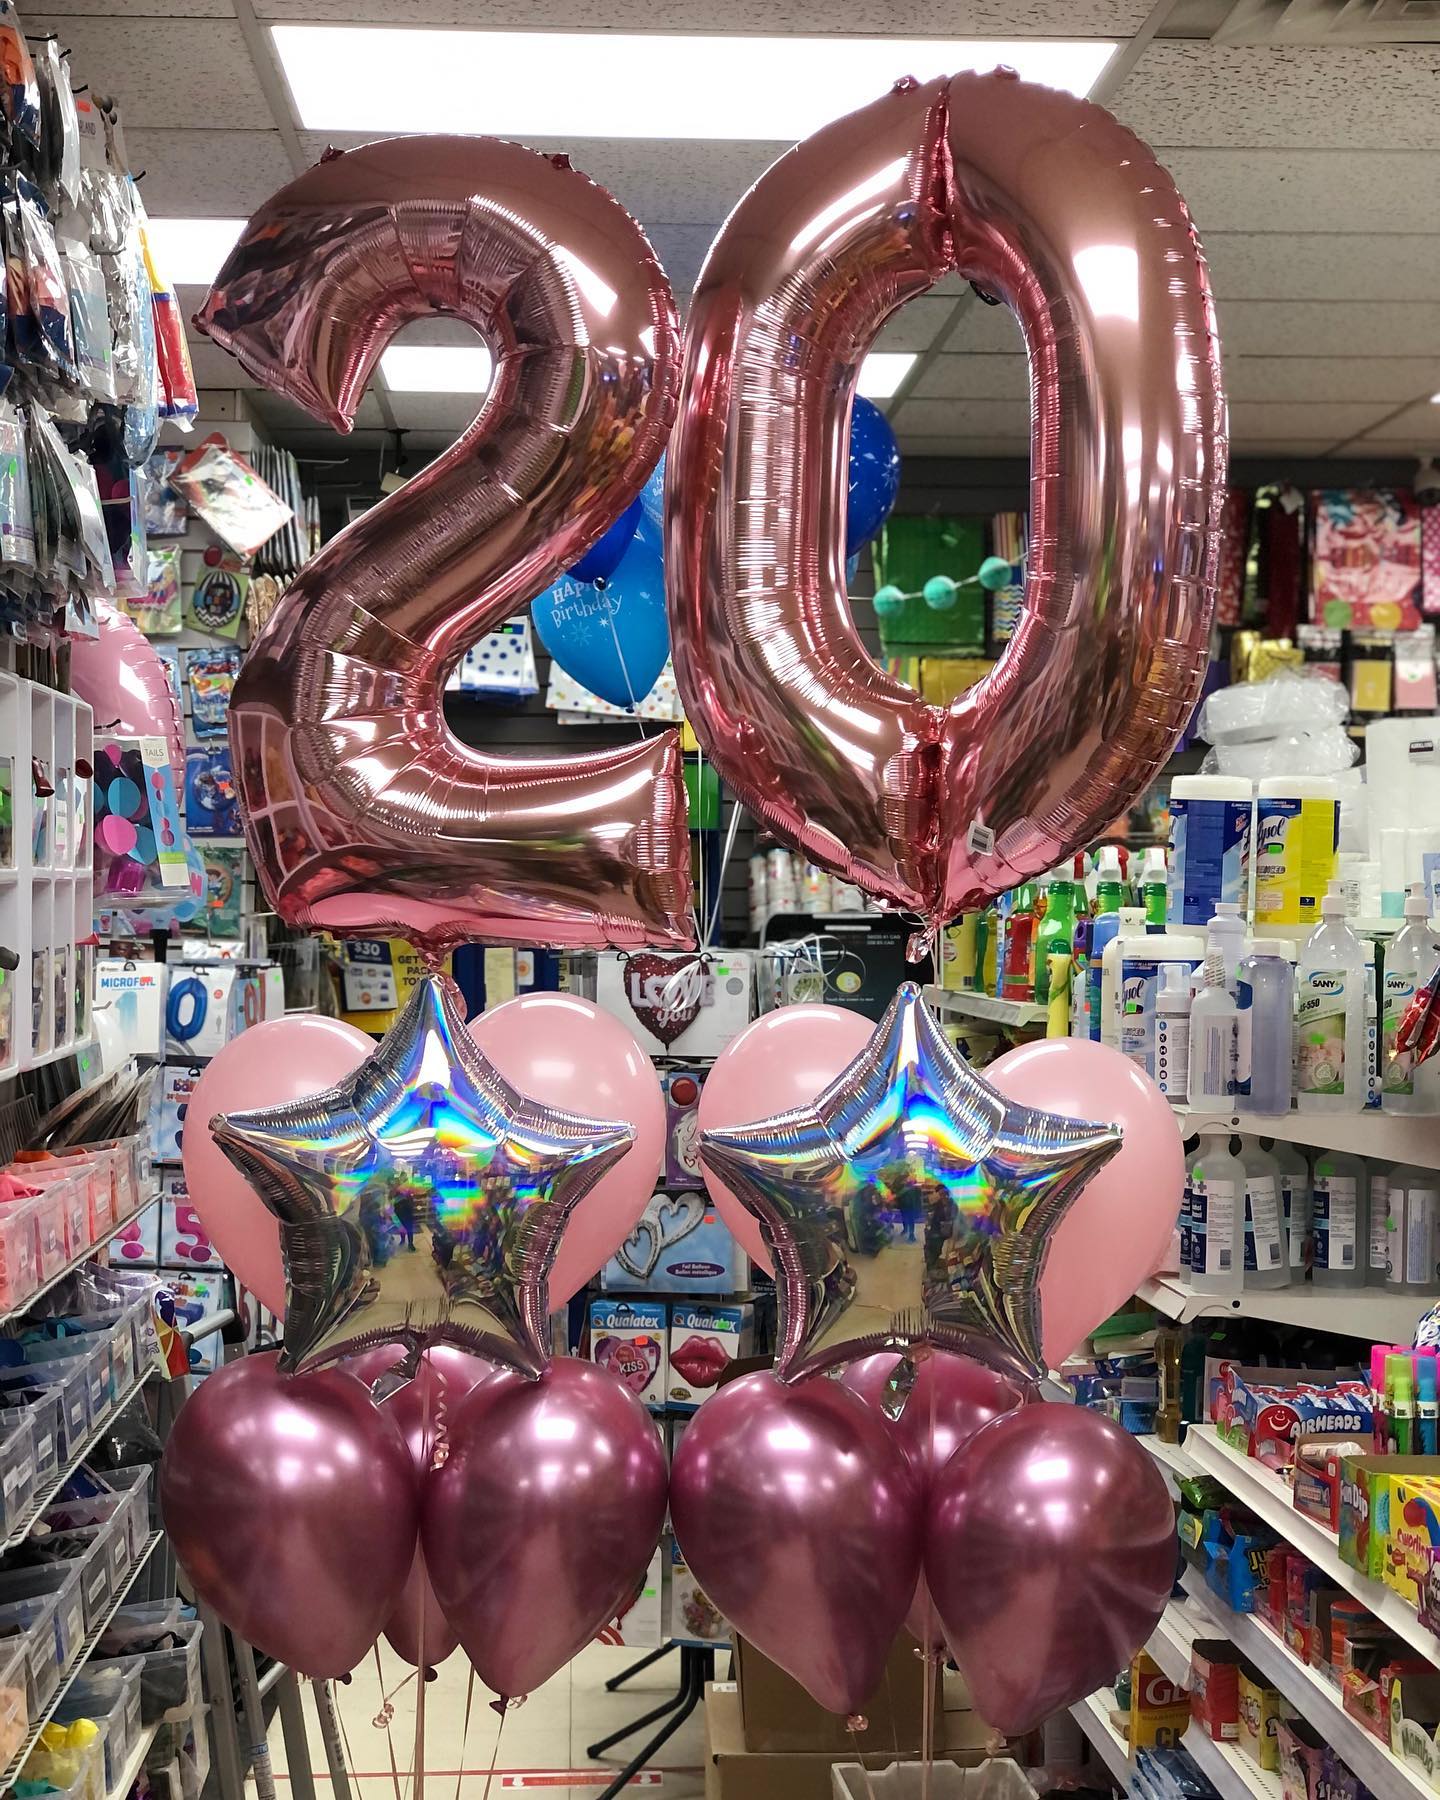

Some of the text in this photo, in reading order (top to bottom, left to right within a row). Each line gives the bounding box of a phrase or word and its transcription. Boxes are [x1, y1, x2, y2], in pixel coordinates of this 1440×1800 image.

[552, 580, 614, 606] HAP
[550, 592, 623, 629] Birthday
[144, 748, 165, 757] TAILS
[354, 941, 381, 956] $30
[397, 955, 419, 964] GET
[606, 1314, 659, 1329] Qualatex
[619, 1360, 644, 1374] KISS
[1290, 1414, 1361, 1439] AIRHEADS
